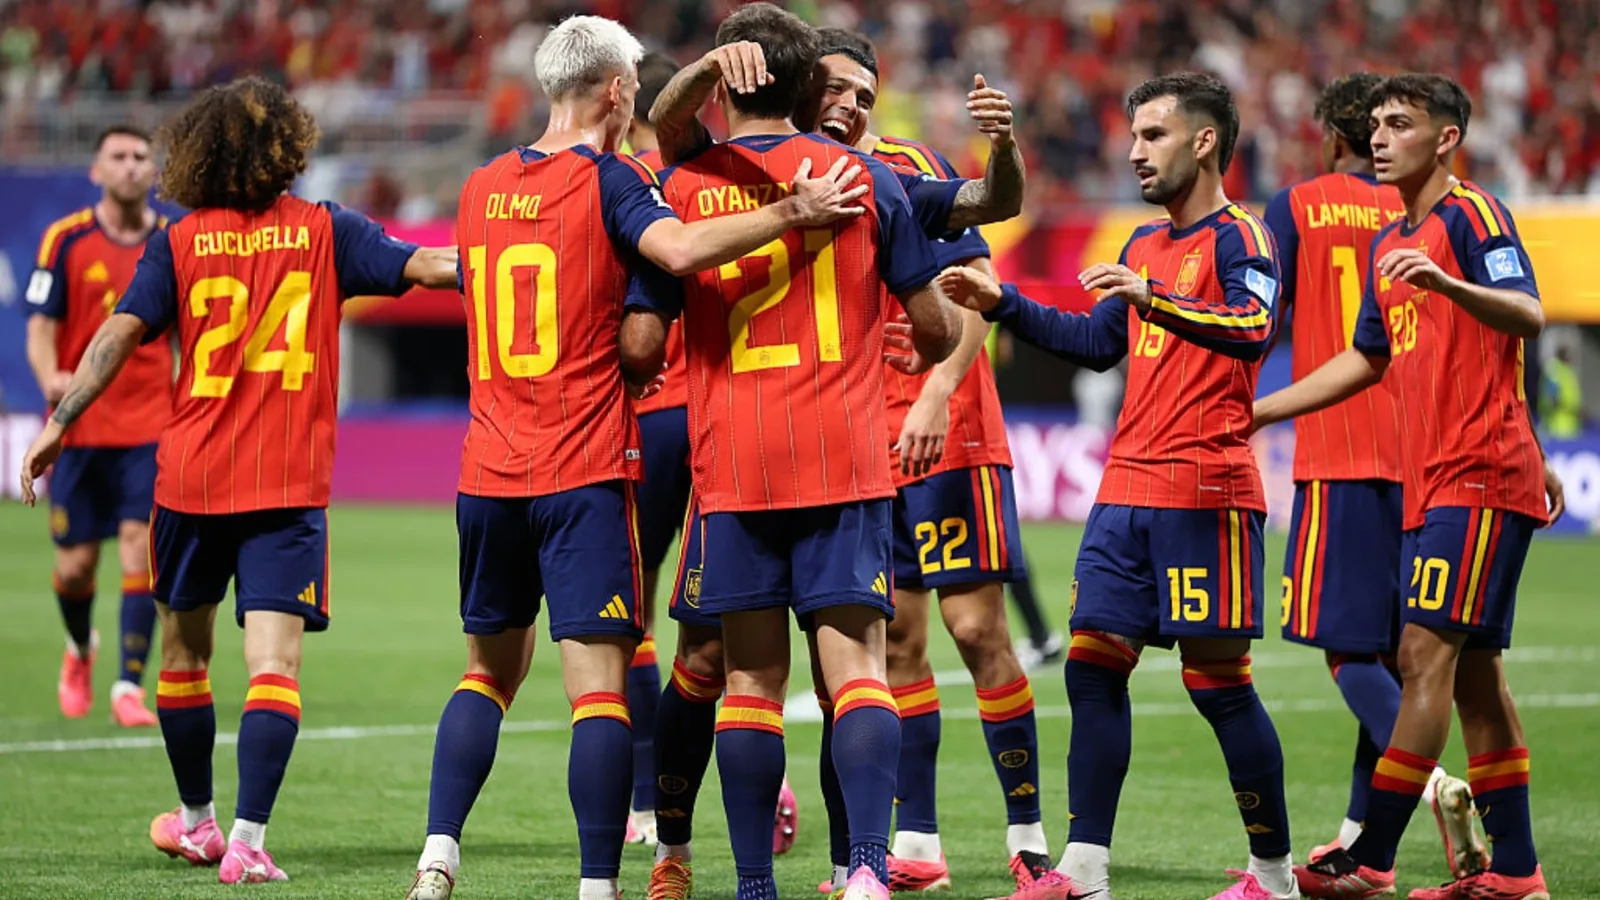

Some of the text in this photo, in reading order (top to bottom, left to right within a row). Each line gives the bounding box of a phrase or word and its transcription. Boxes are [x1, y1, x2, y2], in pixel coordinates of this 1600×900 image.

[486, 194, 541, 220] OLMO
[698, 182, 794, 217] OYARZA
[1306, 203, 1381, 231] LAMINE
[194, 225, 310, 257] CUCURELLA
[468, 243, 559, 380] 10
[719, 230, 842, 374] 21
[1388, 300, 1418, 356] 20
[190, 270, 315, 398] 24
[1134, 321, 1165, 357] 15
[914, 517, 971, 574] 22
[1167, 567, 1209, 622] 15
[1407, 556, 1450, 610] 20
